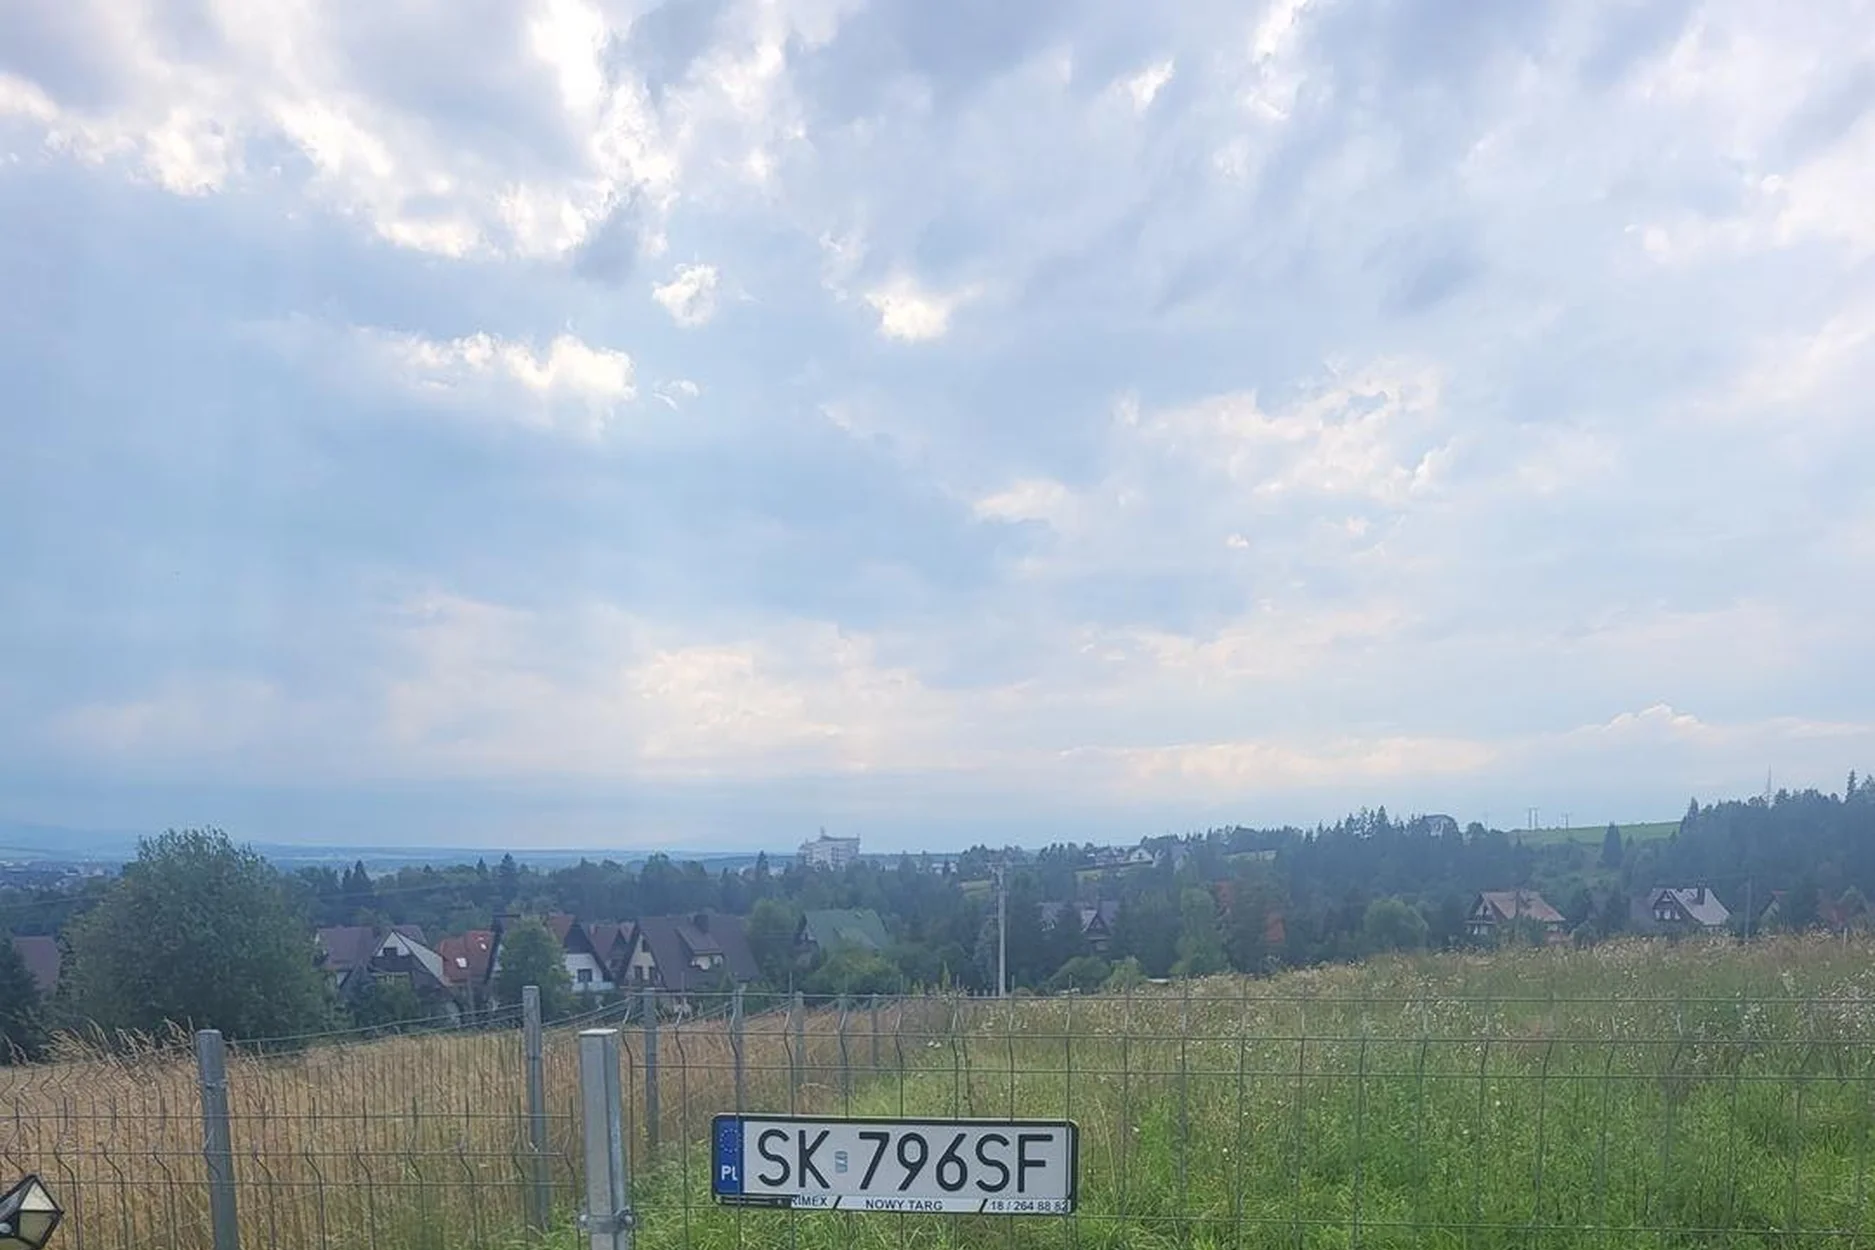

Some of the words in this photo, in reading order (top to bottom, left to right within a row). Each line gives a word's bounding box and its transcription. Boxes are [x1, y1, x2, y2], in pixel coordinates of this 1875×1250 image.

[757, 1128, 831, 1188] SK
[859, 1131, 1054, 1193] 796SF
[721, 1165, 739, 1181] PL
[865, 1199, 905, 1210] NOWY
[908, 1200, 943, 1211] TARG
[991, 1201, 1004, 1211] 18
[1013, 1201, 1034, 1211] 264
